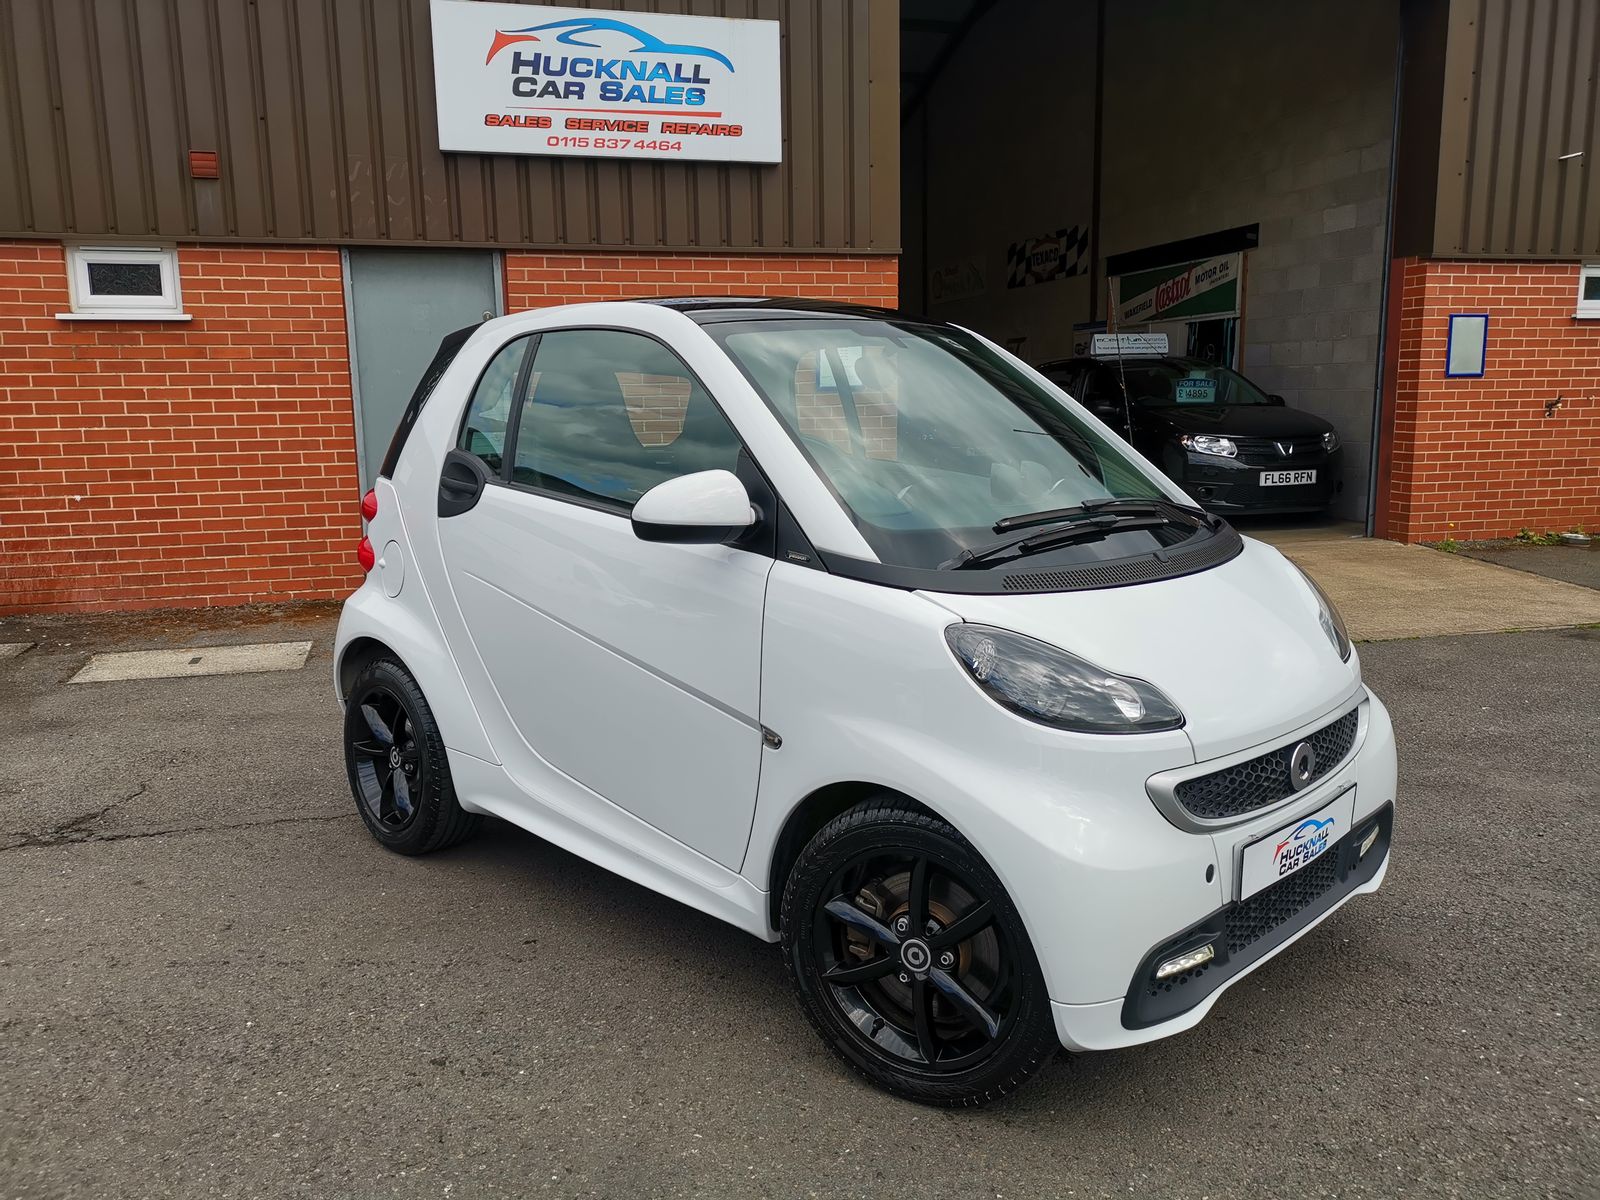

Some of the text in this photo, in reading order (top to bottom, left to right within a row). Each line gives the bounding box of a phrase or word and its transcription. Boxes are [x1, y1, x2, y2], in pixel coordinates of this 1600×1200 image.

[511, 51, 710, 84] HUCKNALL
[512, 77, 706, 105] CAR SALES
[485, 114, 743, 136] SALES SERVICE REPAIRS
[547, 136, 682, 151] 0115 837 4464
[1031, 247, 1059, 266] TEXACO
[1195, 260, 1229, 285] MOTOR OIL
[1123, 298, 1153, 319] WAKEFIELD
[1264, 472, 1313, 484] FL66 RFN
[1279, 839, 1327, 876] CAR SALES
[1280, 828, 1328, 865] HUCKNALL
